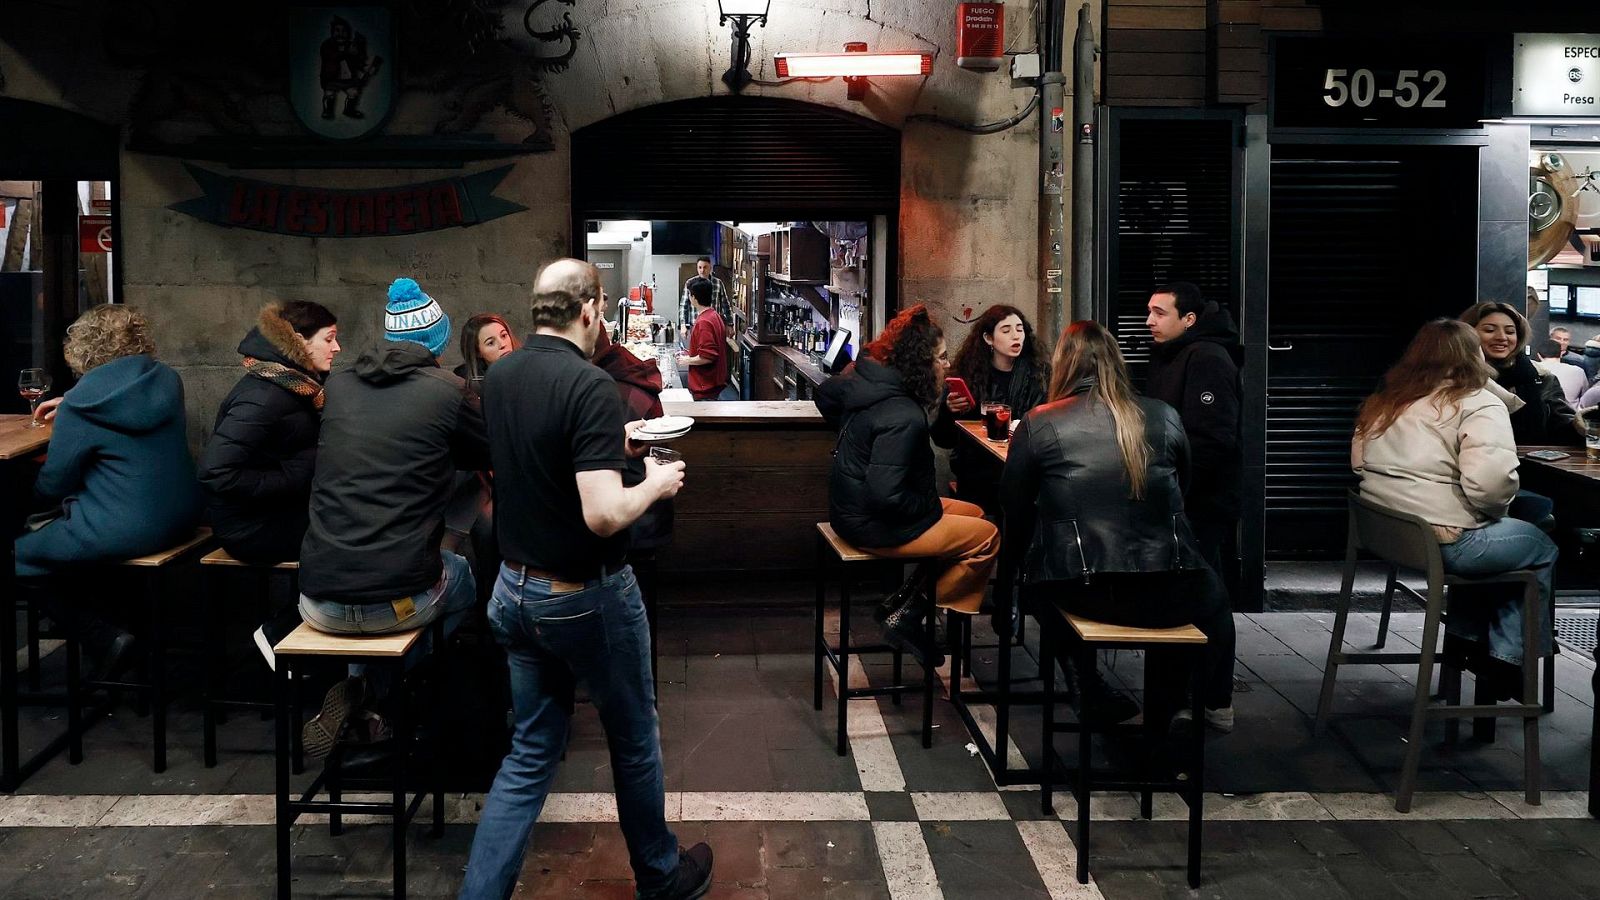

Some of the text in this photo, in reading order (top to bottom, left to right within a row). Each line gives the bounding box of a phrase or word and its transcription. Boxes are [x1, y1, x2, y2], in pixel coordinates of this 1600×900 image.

[971, 7, 995, 15] FUEGO
[1323, 68, 1447, 108] 50-52
[1563, 93, 1594, 104] Presa
[229, 182, 464, 235] LA ESTAFETA
